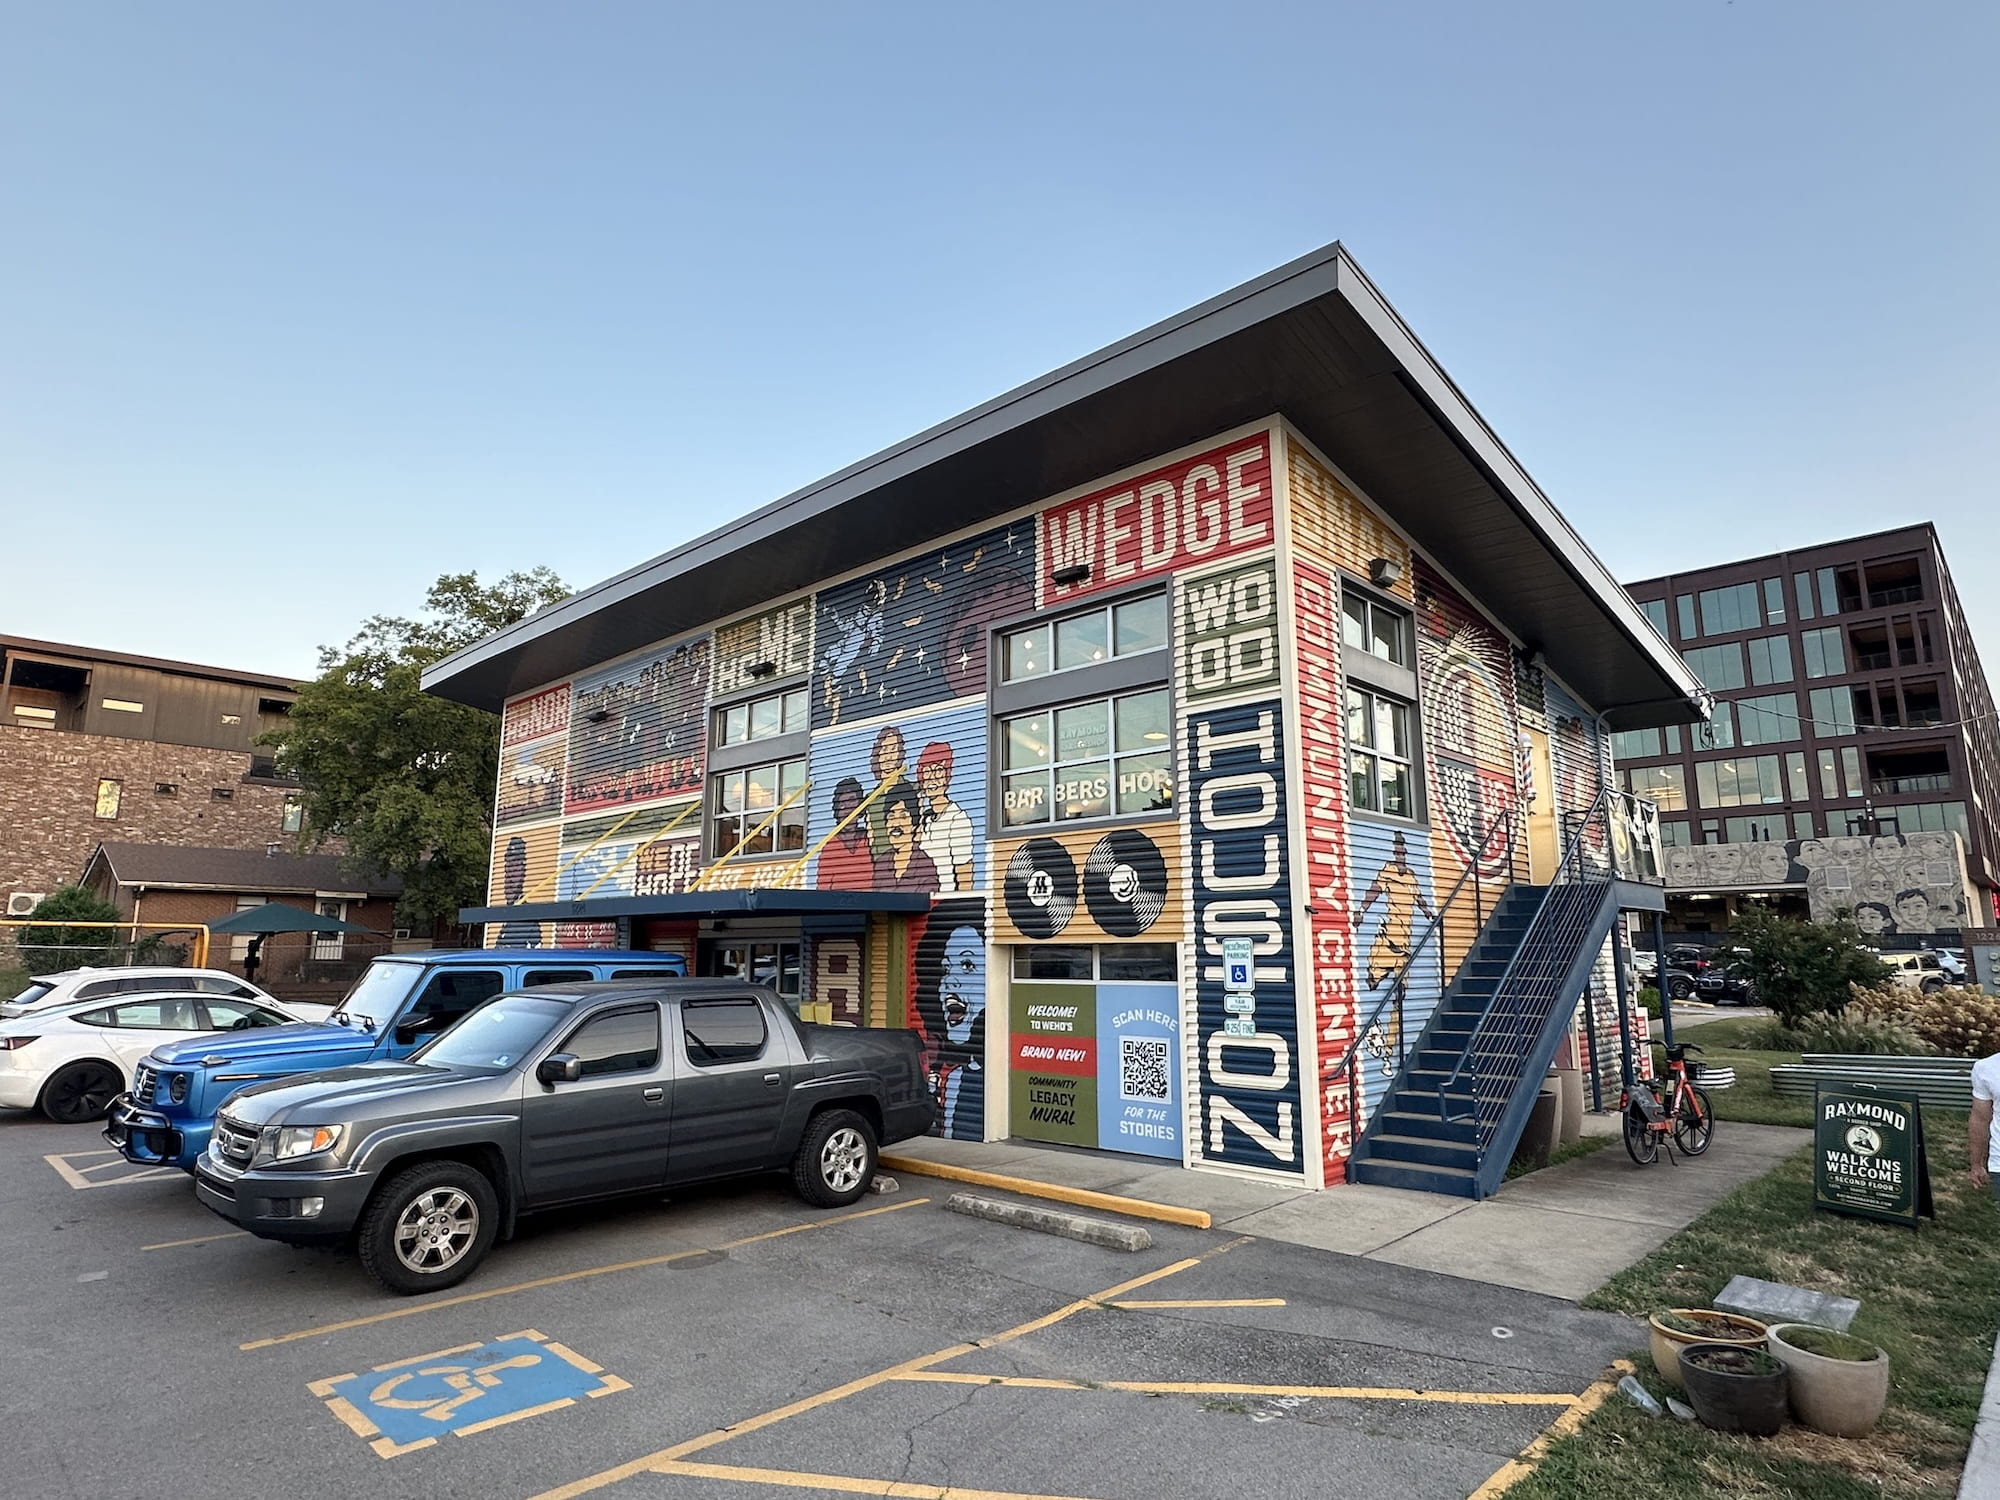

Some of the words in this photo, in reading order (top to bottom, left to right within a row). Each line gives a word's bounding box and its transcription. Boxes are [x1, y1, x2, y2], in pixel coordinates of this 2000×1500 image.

[1048, 445, 1268, 596] WEDGE
[1301, 578, 1343, 912] COMMUNITY
[1197, 709, 1295, 1162] HOUSTON
[1027, 1005, 1078, 1018] WELCOME!
[1112, 1008, 1144, 1028] SCAN
[1146, 1009, 1178, 1032] HERE
[1030, 1020, 1041, 1030] TO
[1041, 1021, 1073, 1032] WEHO'S
[1242, 1024, 1255, 1034] FINE
[1020, 1045, 1055, 1060] BRAND
[1055, 1048, 1087, 1062] NEW!
[1317, 929, 1351, 1161] CENTER
[1028, 1076, 1078, 1089] COMMUNITY
[1030, 1089, 1076, 1107] LEGACY
[1029, 1106, 1076, 1126] MURAL
[1124, 1106, 1145, 1119] FOR
[1146, 1108, 1168, 1121] THE
[1120, 1120, 1175, 1141] STORIES
[1826, 1150, 1873, 1168] WALK
[1875, 1158, 1901, 1172] INS
[1825, 1161, 1902, 1184] WELCOME
[1834, 1175, 1867, 1187] SECOND
[1868, 1181, 1894, 1192] FLOOR
